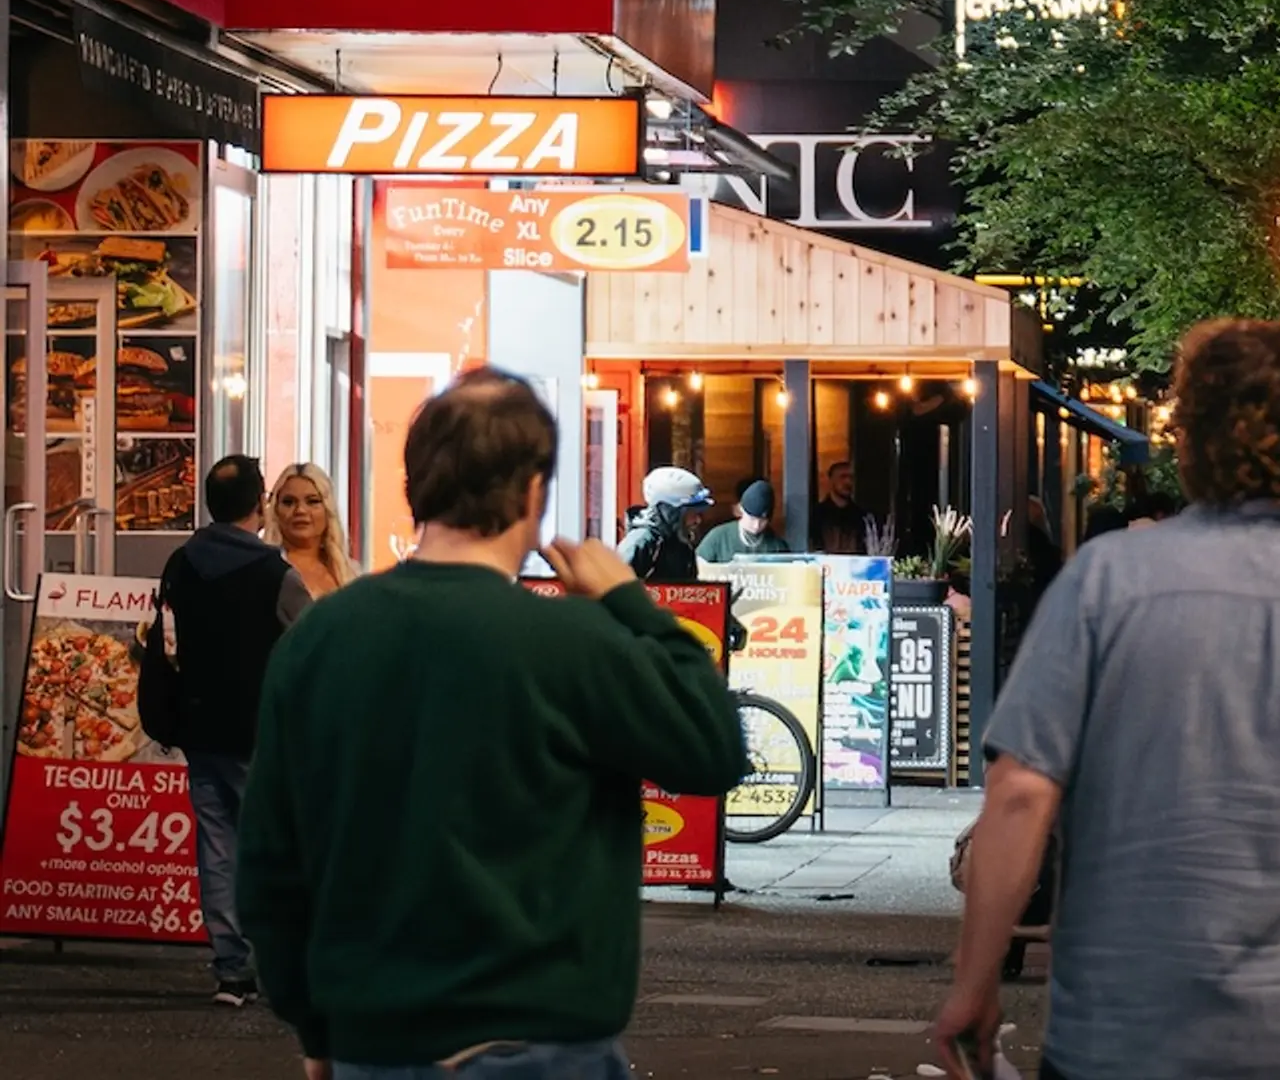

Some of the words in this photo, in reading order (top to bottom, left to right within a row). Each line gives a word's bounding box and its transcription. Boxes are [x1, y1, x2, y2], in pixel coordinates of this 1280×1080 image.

[326, 98, 579, 172] PIZZA
[392, 197, 505, 233] FunTime
[509, 194, 549, 217] Any
[516, 221, 540, 240] XL
[576, 218, 652, 247] 2.15
[503, 247, 553, 267] Slice
[76, 589, 170, 612] FLAM
[665, 586, 721, 605] PIZZA
[837, 582, 882, 596] VAPE
[750, 616, 808, 643] 24
[891, 638, 933, 673] .95
[891, 683, 933, 719] NU
[44, 765, 145, 792] TEQUILA
[153, 771, 190, 794] SH
[106, 793, 151, 809] ONLY
[56, 800, 191, 855] $3.49
[90, 859, 144, 874] alcohol
[147, 862, 199, 877] options
[4, 879, 53, 895] FOOD
[56, 881, 134, 899] STARTING
[136, 887, 159, 901] AT
[6, 904, 42, 919] ANY
[46, 905, 98, 923] SMALL
[103, 908, 147, 925] PIZZA
